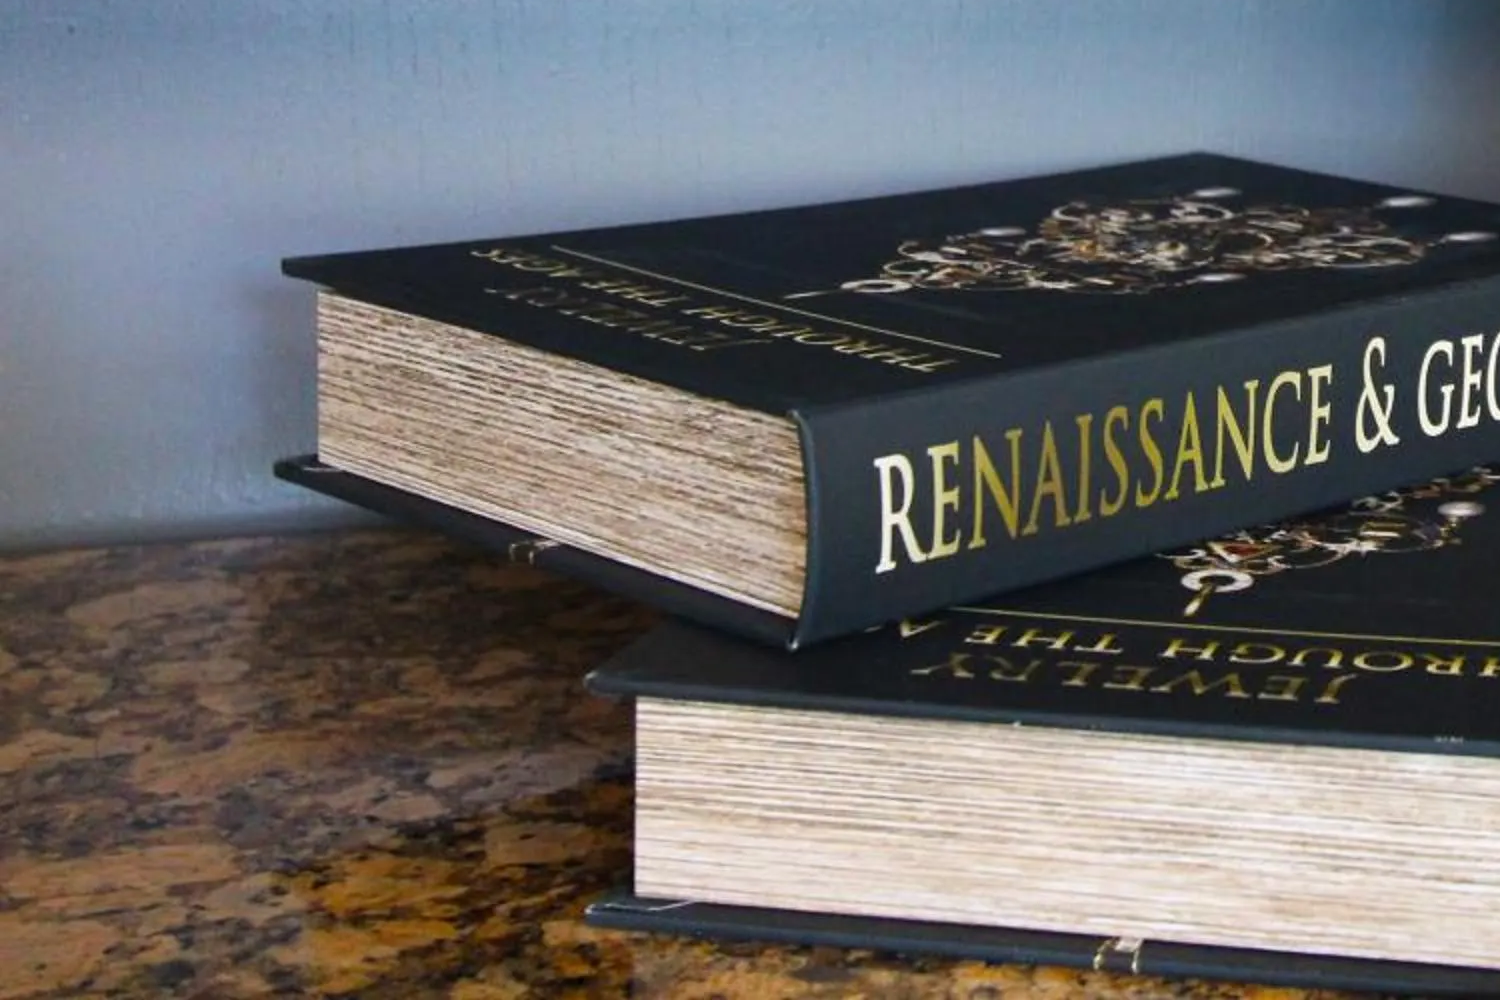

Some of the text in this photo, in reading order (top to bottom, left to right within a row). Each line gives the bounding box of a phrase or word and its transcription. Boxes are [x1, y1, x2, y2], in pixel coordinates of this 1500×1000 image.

[874, 364, 1334, 574] RENAISSANCE
[1354, 336, 1400, 455] &
[965, 621, 1124, 655] THE
[910, 652, 1358, 705] JEWELRY
